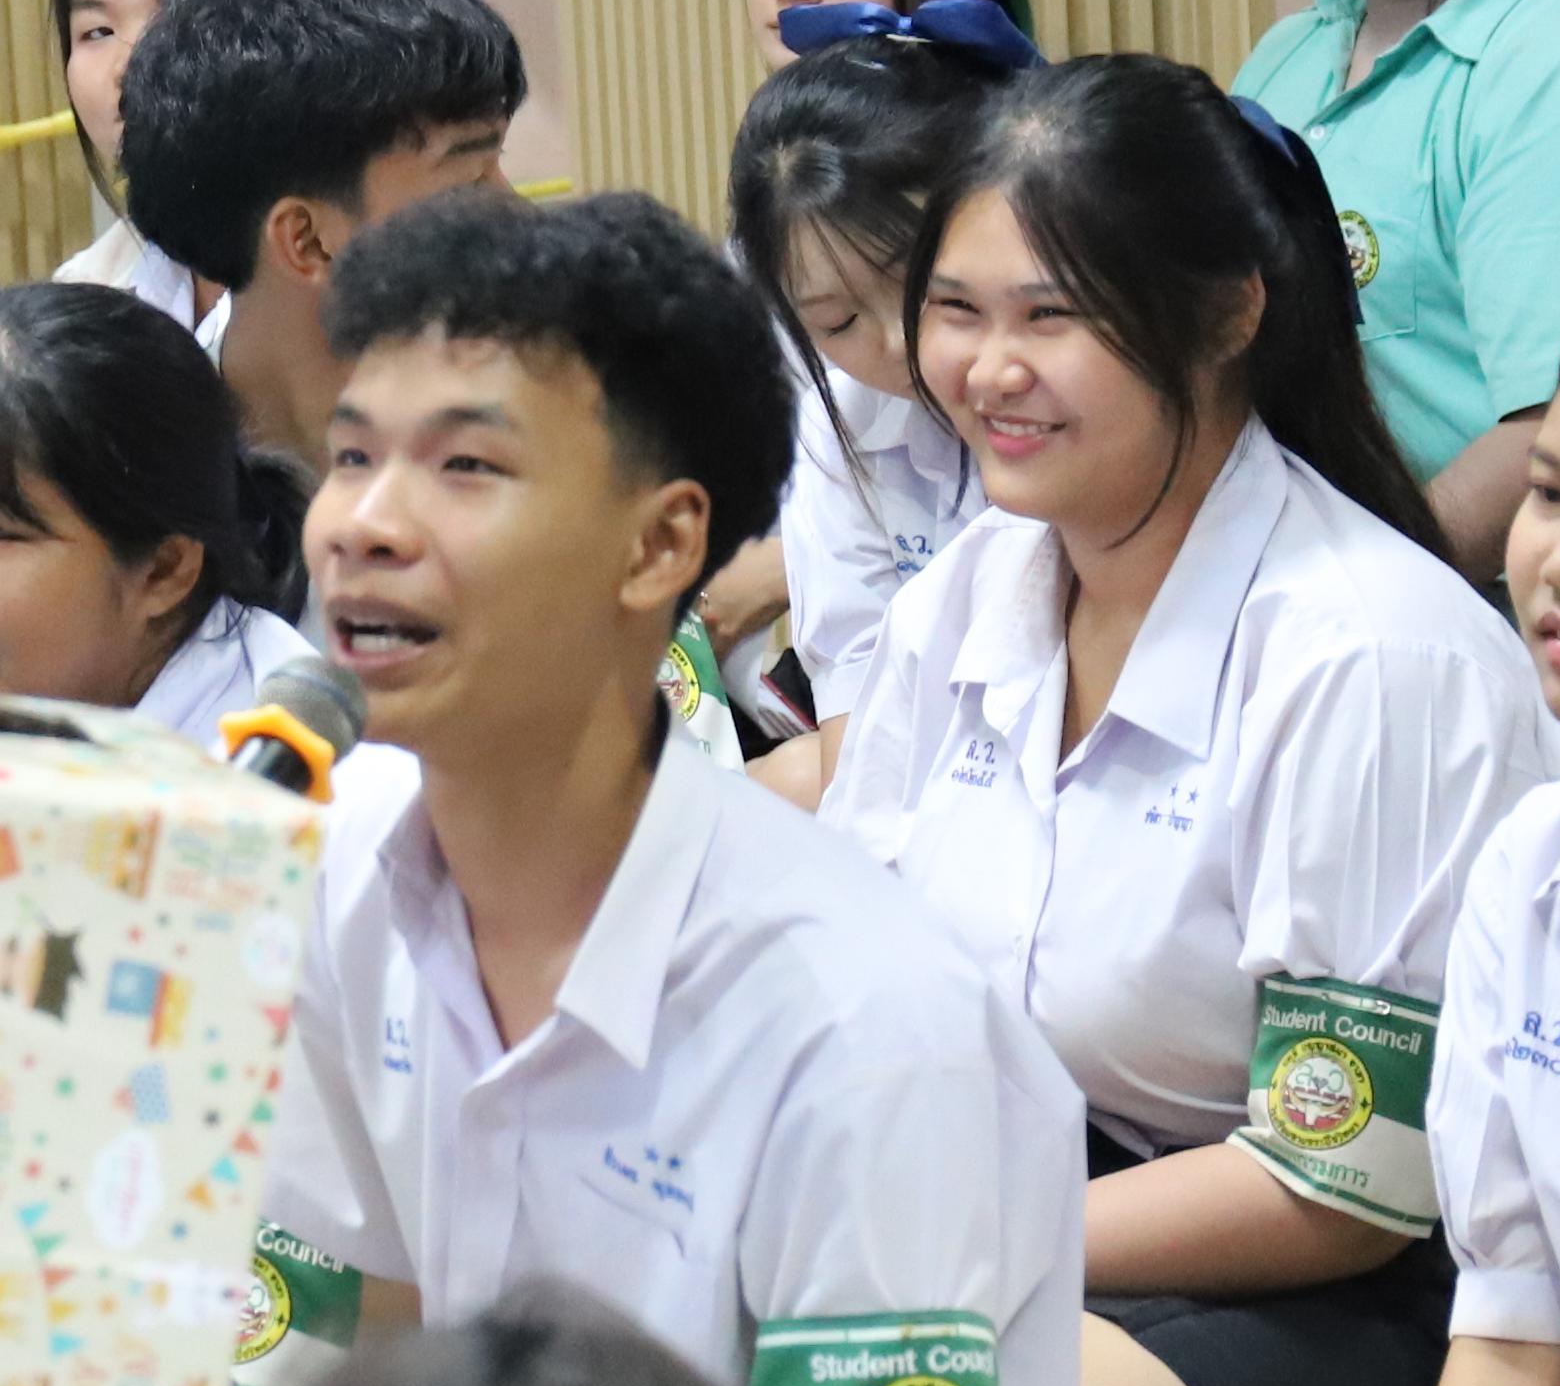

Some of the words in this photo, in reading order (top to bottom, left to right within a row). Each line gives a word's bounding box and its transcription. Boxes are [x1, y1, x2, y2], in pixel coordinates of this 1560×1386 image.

[1263, 1004, 1328, 1034] Student
[1335, 1015, 1424, 1056] Council
[256, 1227, 345, 1275] Council
[809, 1348, 920, 1383] Student
